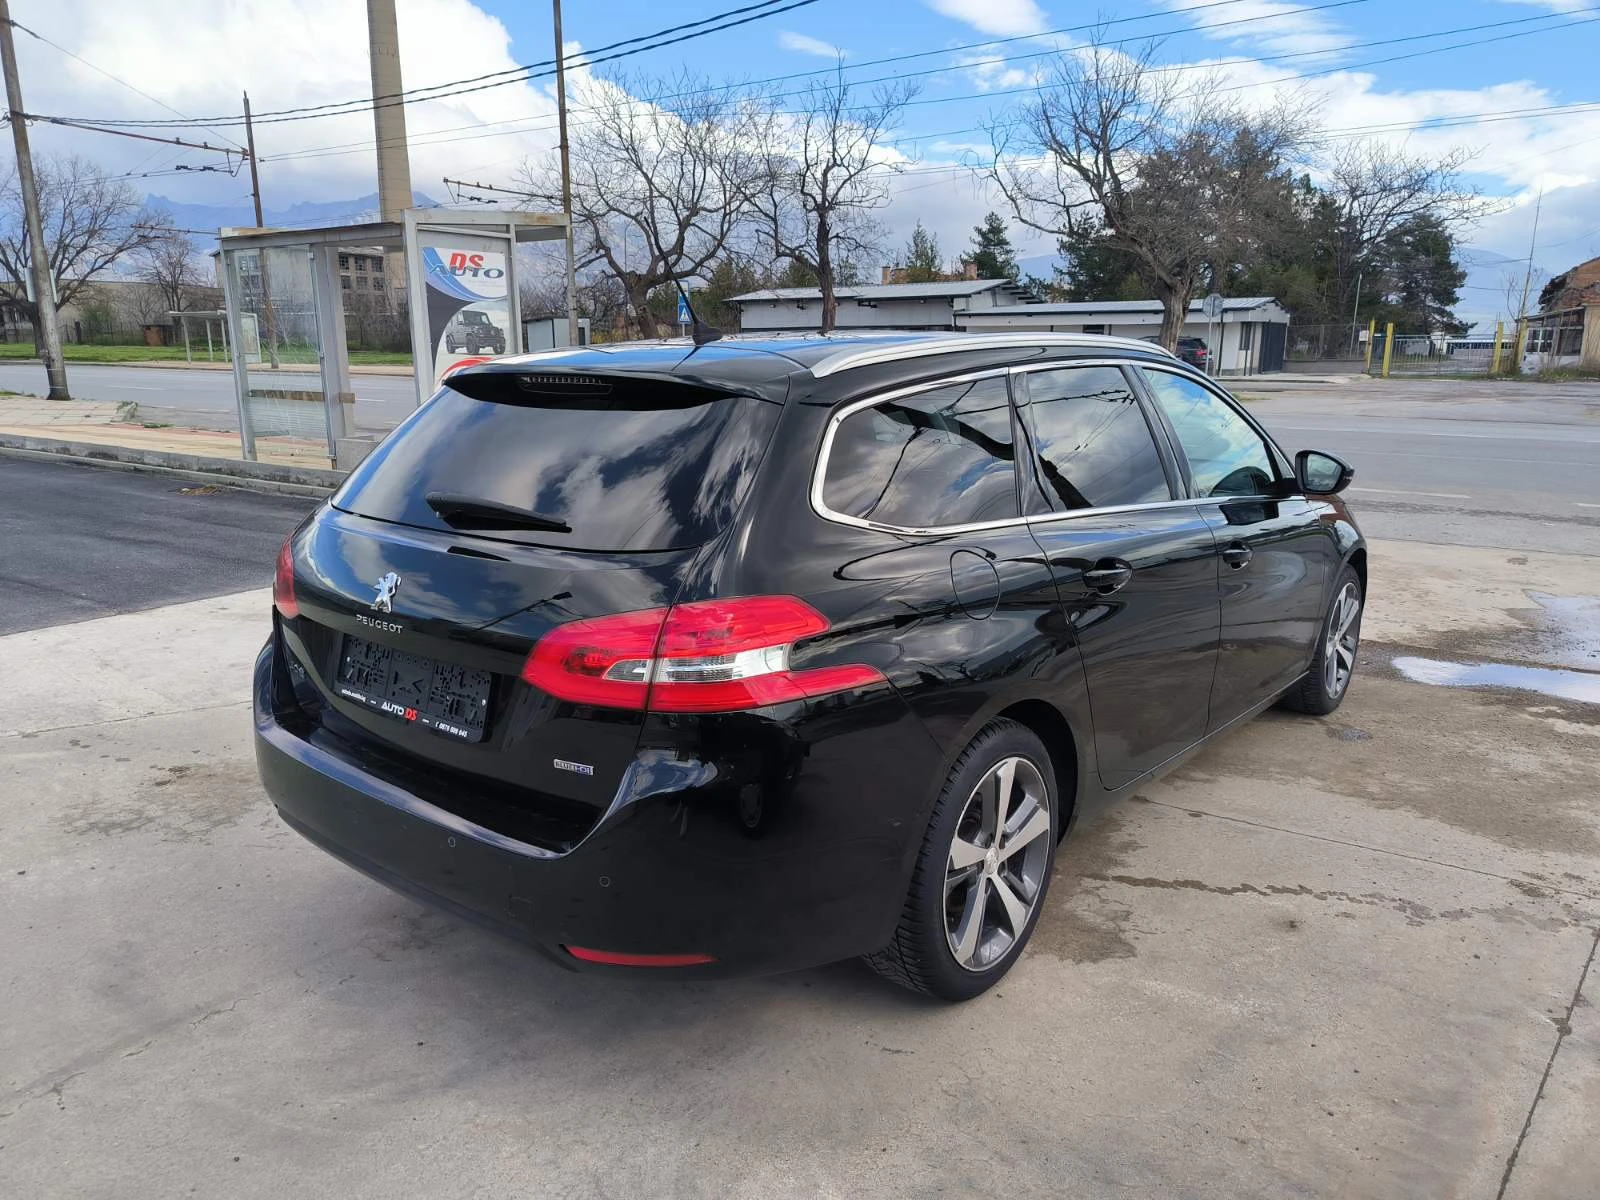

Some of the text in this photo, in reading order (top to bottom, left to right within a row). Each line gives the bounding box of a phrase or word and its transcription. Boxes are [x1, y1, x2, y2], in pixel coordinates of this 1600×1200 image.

[429, 263, 504, 279] AUTO
[449, 252, 484, 271] DS
[356, 614, 403, 634] PEUGEOT
[381, 701, 418, 721] AUTO DS
